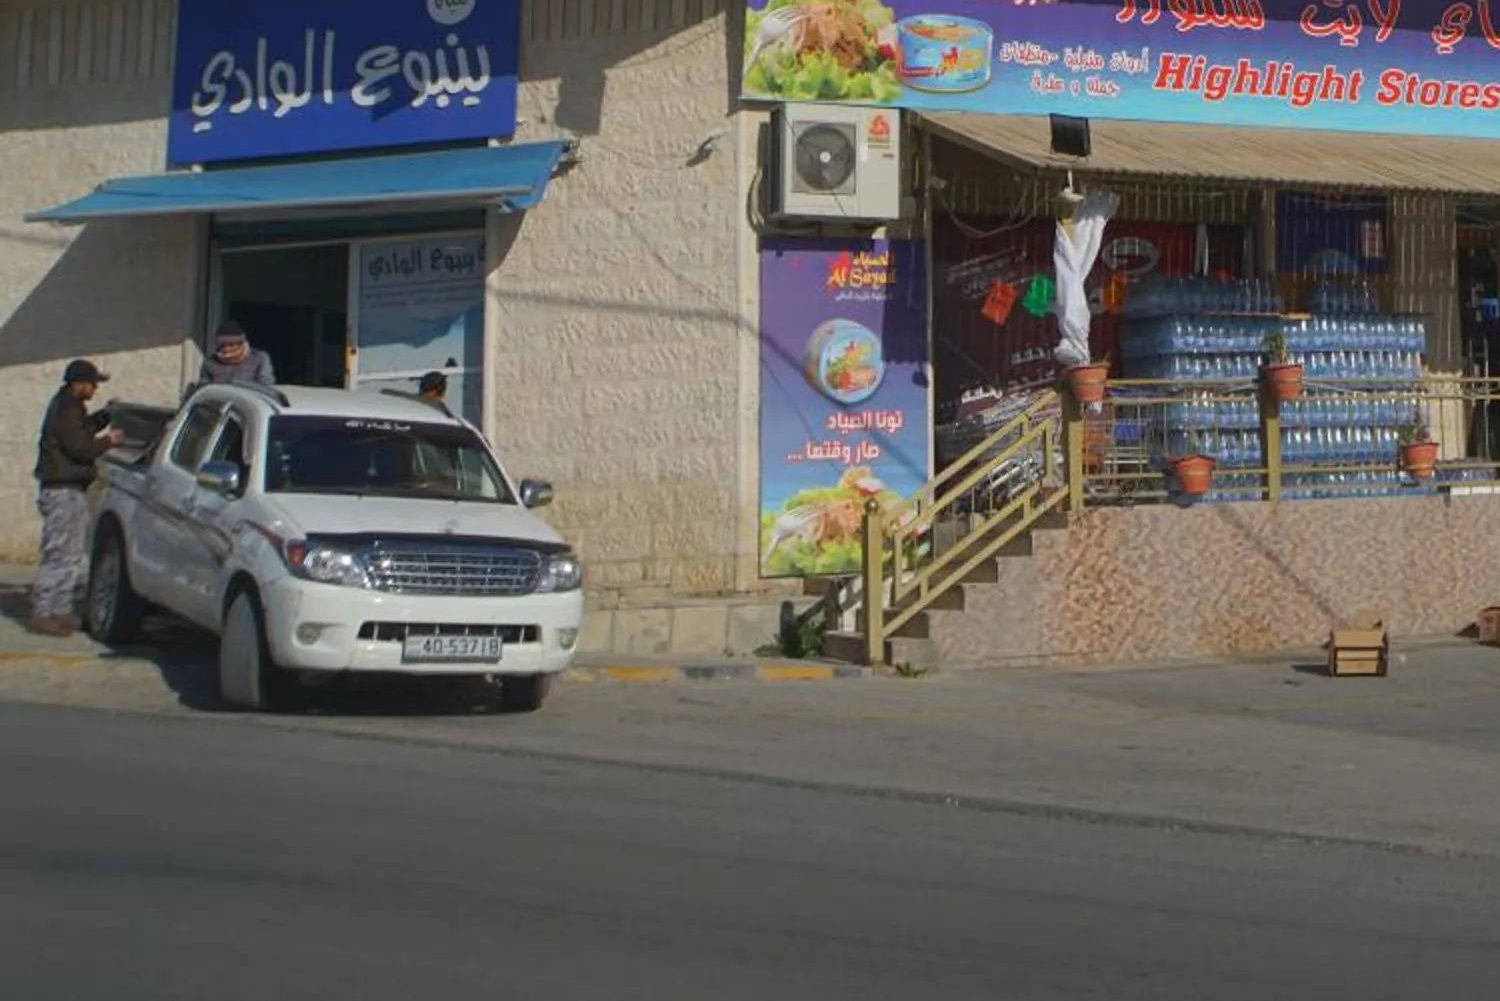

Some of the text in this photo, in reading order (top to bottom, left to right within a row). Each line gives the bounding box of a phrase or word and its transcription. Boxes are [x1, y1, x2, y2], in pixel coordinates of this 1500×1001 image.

[191, 28, 491, 134] ينبوع الوادي
[1153, 51, 1366, 108] Highlight
[826, 410, 903, 435] تونا الصياد
[806, 440, 851, 464] وقتها
[856, 440, 880, 463] صار
